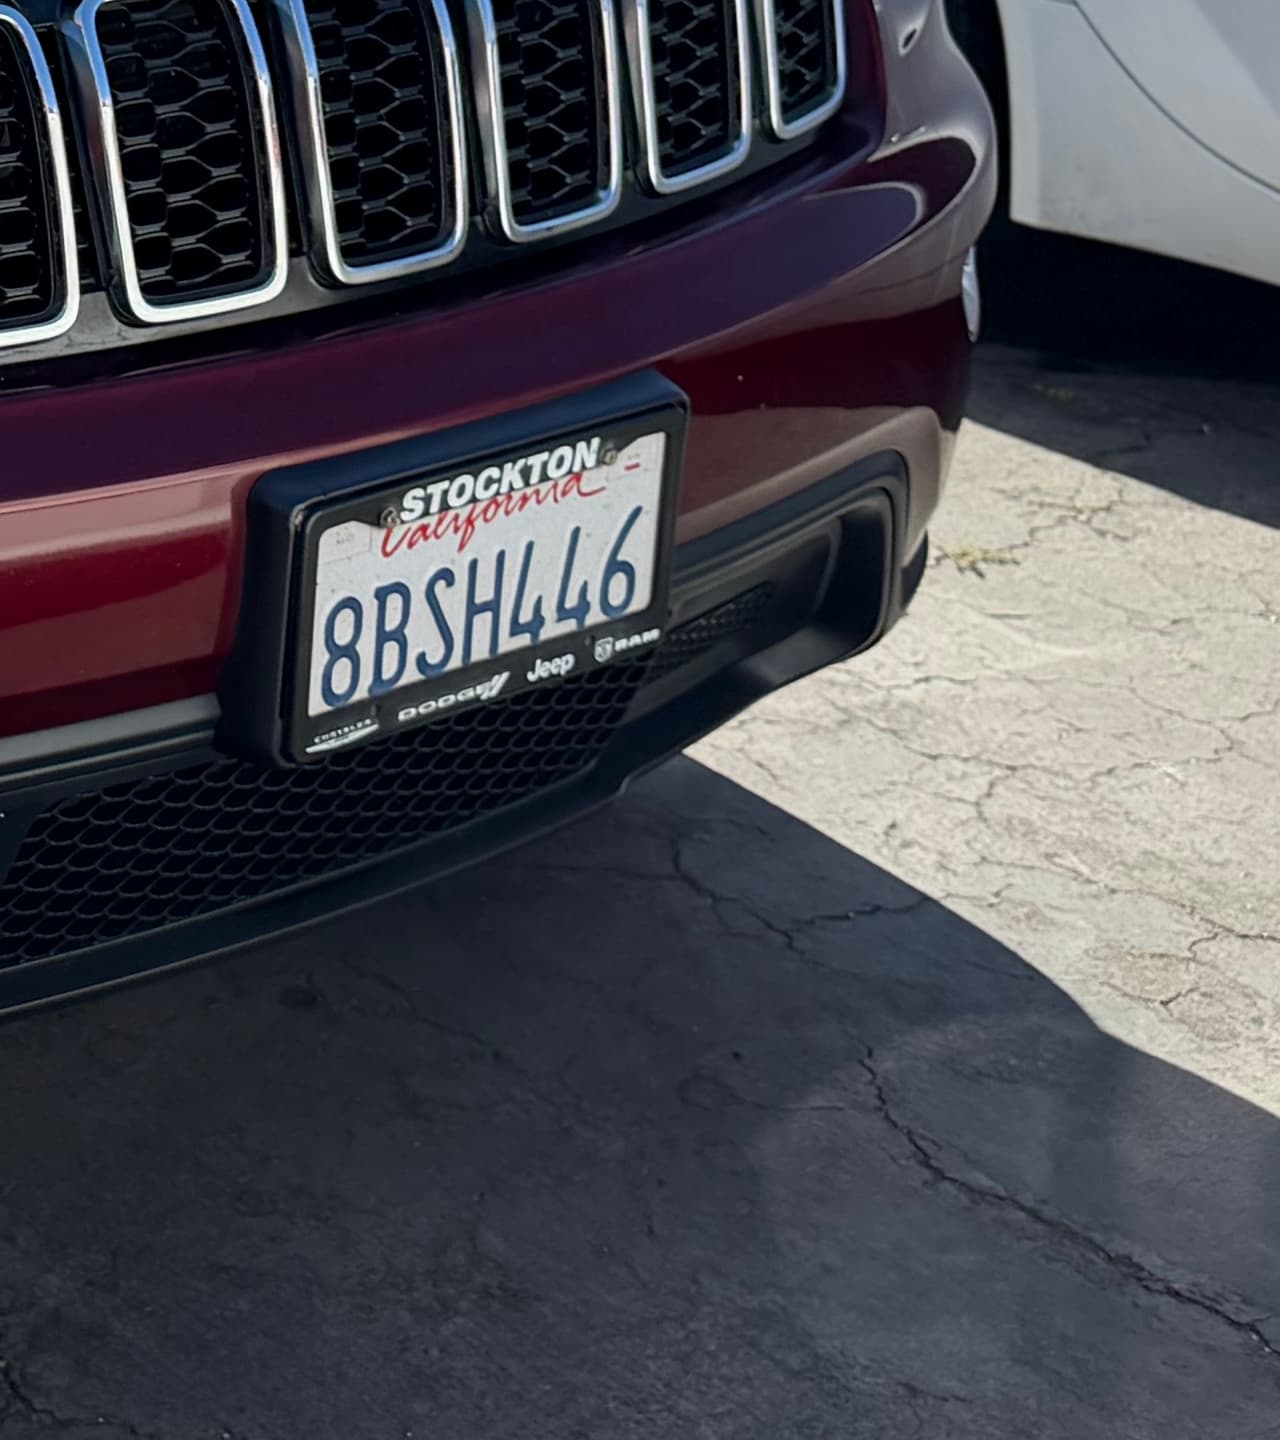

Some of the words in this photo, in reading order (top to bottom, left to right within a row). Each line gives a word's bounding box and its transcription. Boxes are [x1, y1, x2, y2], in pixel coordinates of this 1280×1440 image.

[399, 436, 602, 523] STOCKTON
[320, 505, 643, 709] 8BSH446
[526, 653, 575, 683] Jeep
[614, 628, 662, 653] RAM
